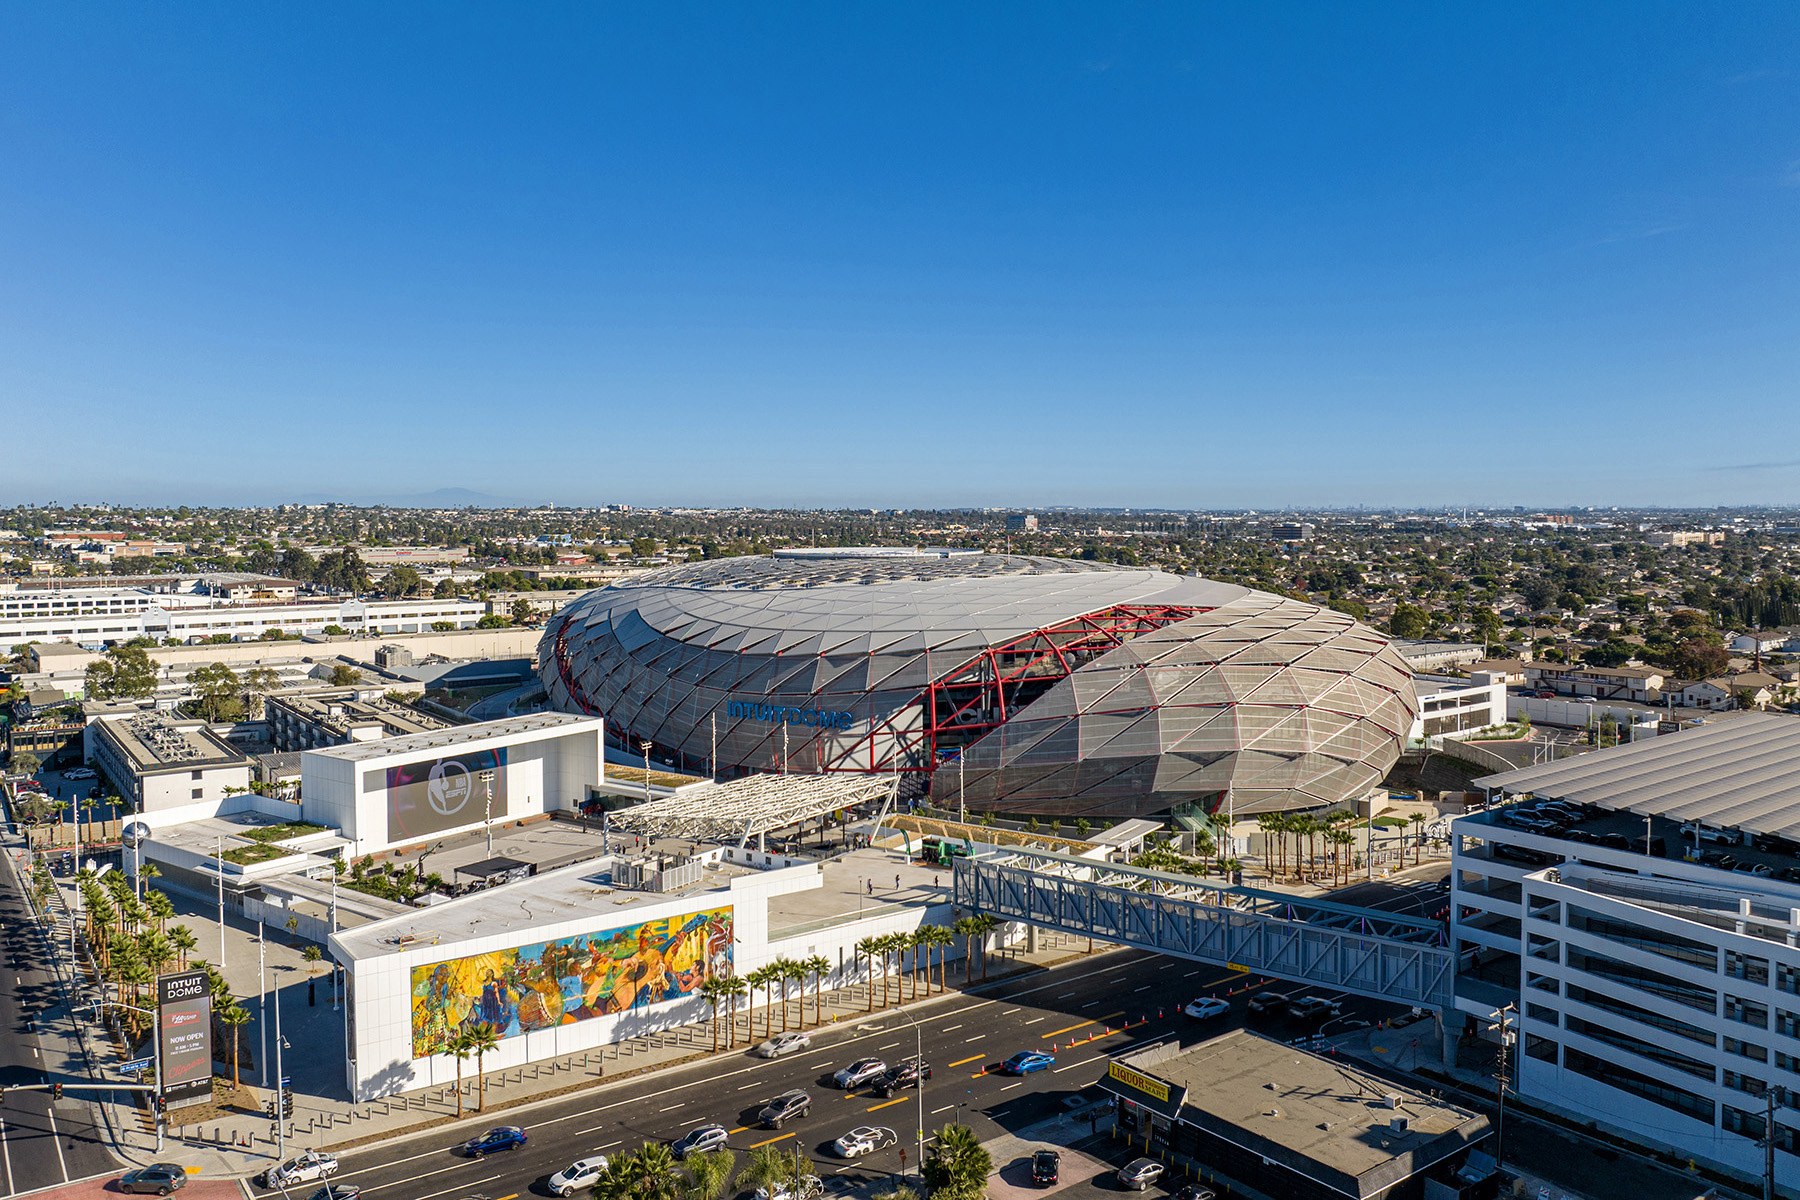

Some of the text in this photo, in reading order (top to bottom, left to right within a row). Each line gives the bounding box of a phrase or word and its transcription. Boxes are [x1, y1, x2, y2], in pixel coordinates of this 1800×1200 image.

[445, 788, 466, 799] ESPN
[167, 977, 202, 990] INTUIT
[170, 1032, 204, 1044] NOW OPEN
[168, 1056, 206, 1079] Clippers
[1111, 1065, 1145, 1090] LIQUOR
[1145, 1085, 1166, 1098] MART
